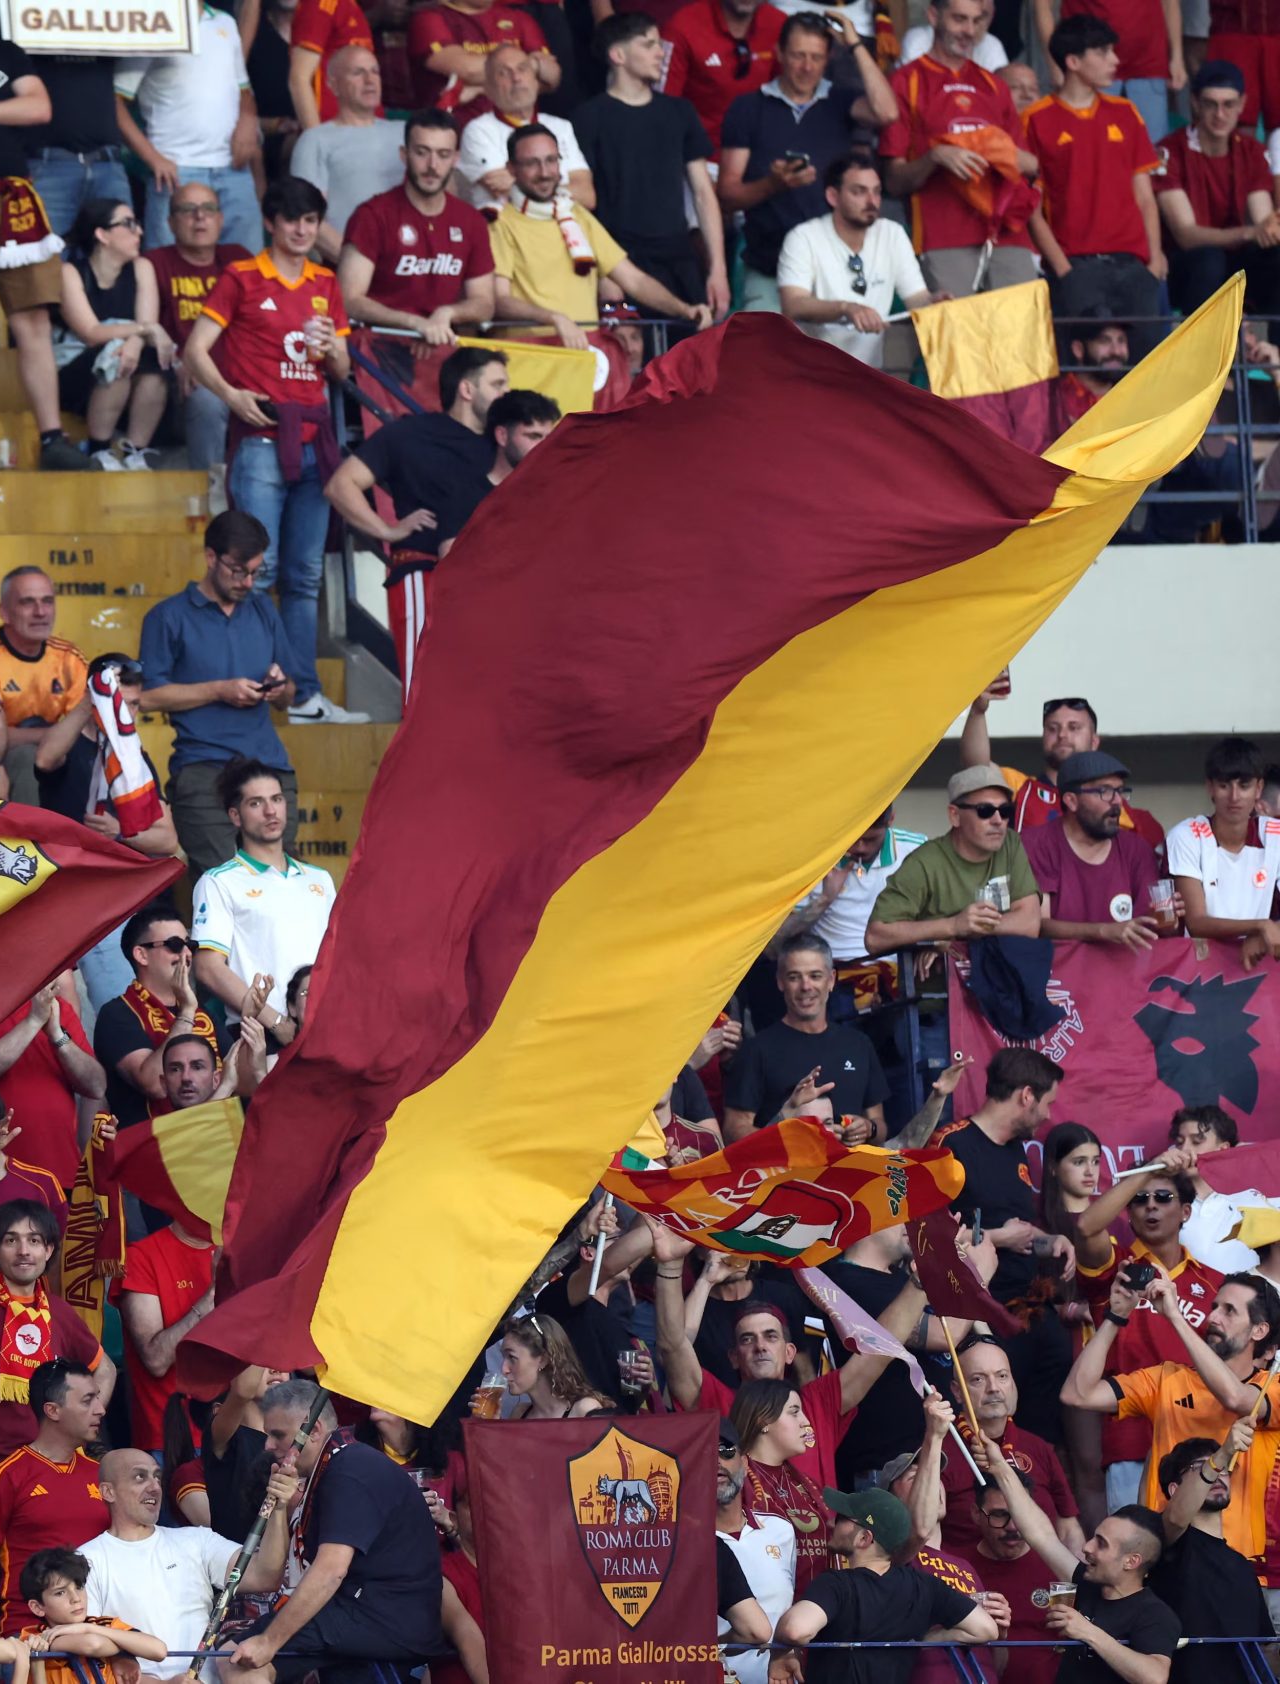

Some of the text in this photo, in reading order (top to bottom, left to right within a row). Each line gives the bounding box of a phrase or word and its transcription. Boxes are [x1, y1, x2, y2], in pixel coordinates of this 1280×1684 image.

[21, 8, 173, 33] GALLURA
[395, 253, 463, 275] Barilla
[50, 550, 78, 565] FILA
[55, 582, 107, 595] ETTORE
[296, 841, 346, 856] ETTORE
[586, 1529, 671, 1549] ROMA CLUB
[796, 1538, 827, 1547] IYADH
[796, 1548, 828, 1557] EASON
[603, 1556, 660, 1576] PARMA
[612, 1586, 648, 1599] FRANCESCO
[623, 1602, 640, 1615] TOTTI
[541, 1641, 720, 1667] Parma Giallorossa
